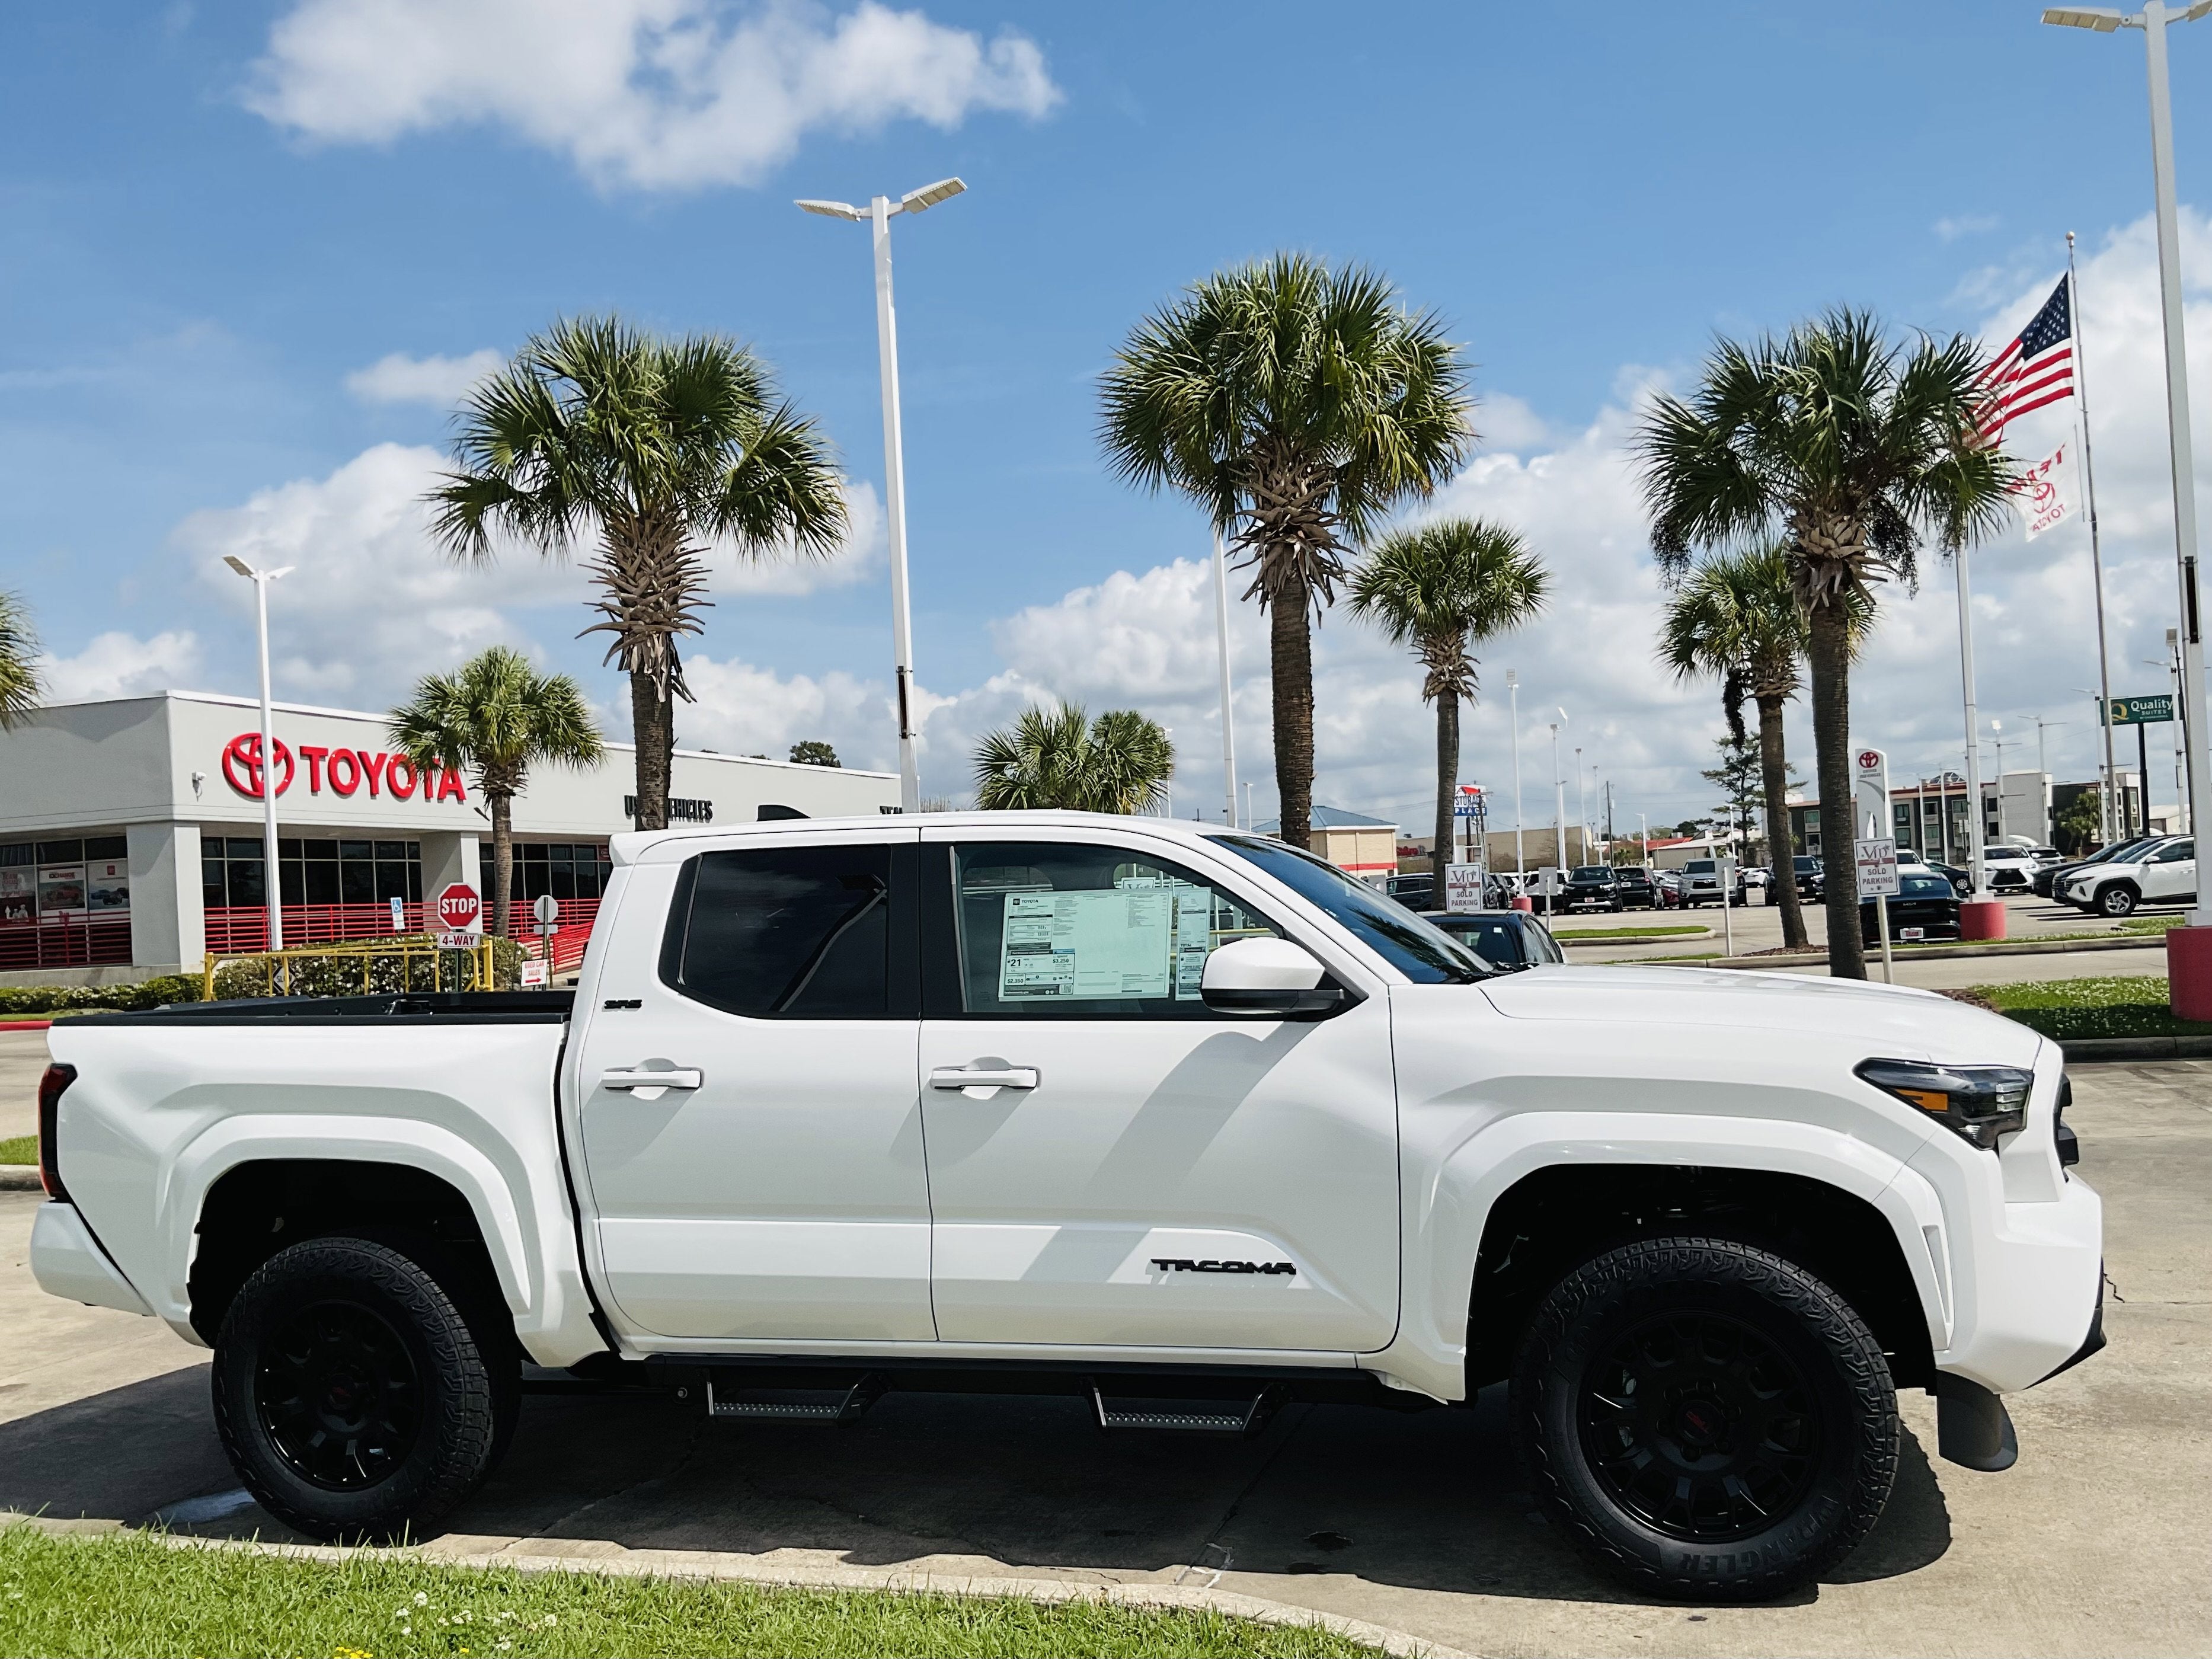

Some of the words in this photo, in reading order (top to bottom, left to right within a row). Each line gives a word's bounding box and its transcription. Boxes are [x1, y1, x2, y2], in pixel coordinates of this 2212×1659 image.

[2131, 699, 2173, 712] Quality
[668, 798, 713, 820] EHICLES
[1862, 877, 1893, 885] PARKING
[442, 898, 477, 914] STOP
[442, 935, 475, 945] 4-WAY
[1011, 958, 1021, 967] 21
[1150, 1258, 1296, 1275] TACOMA
